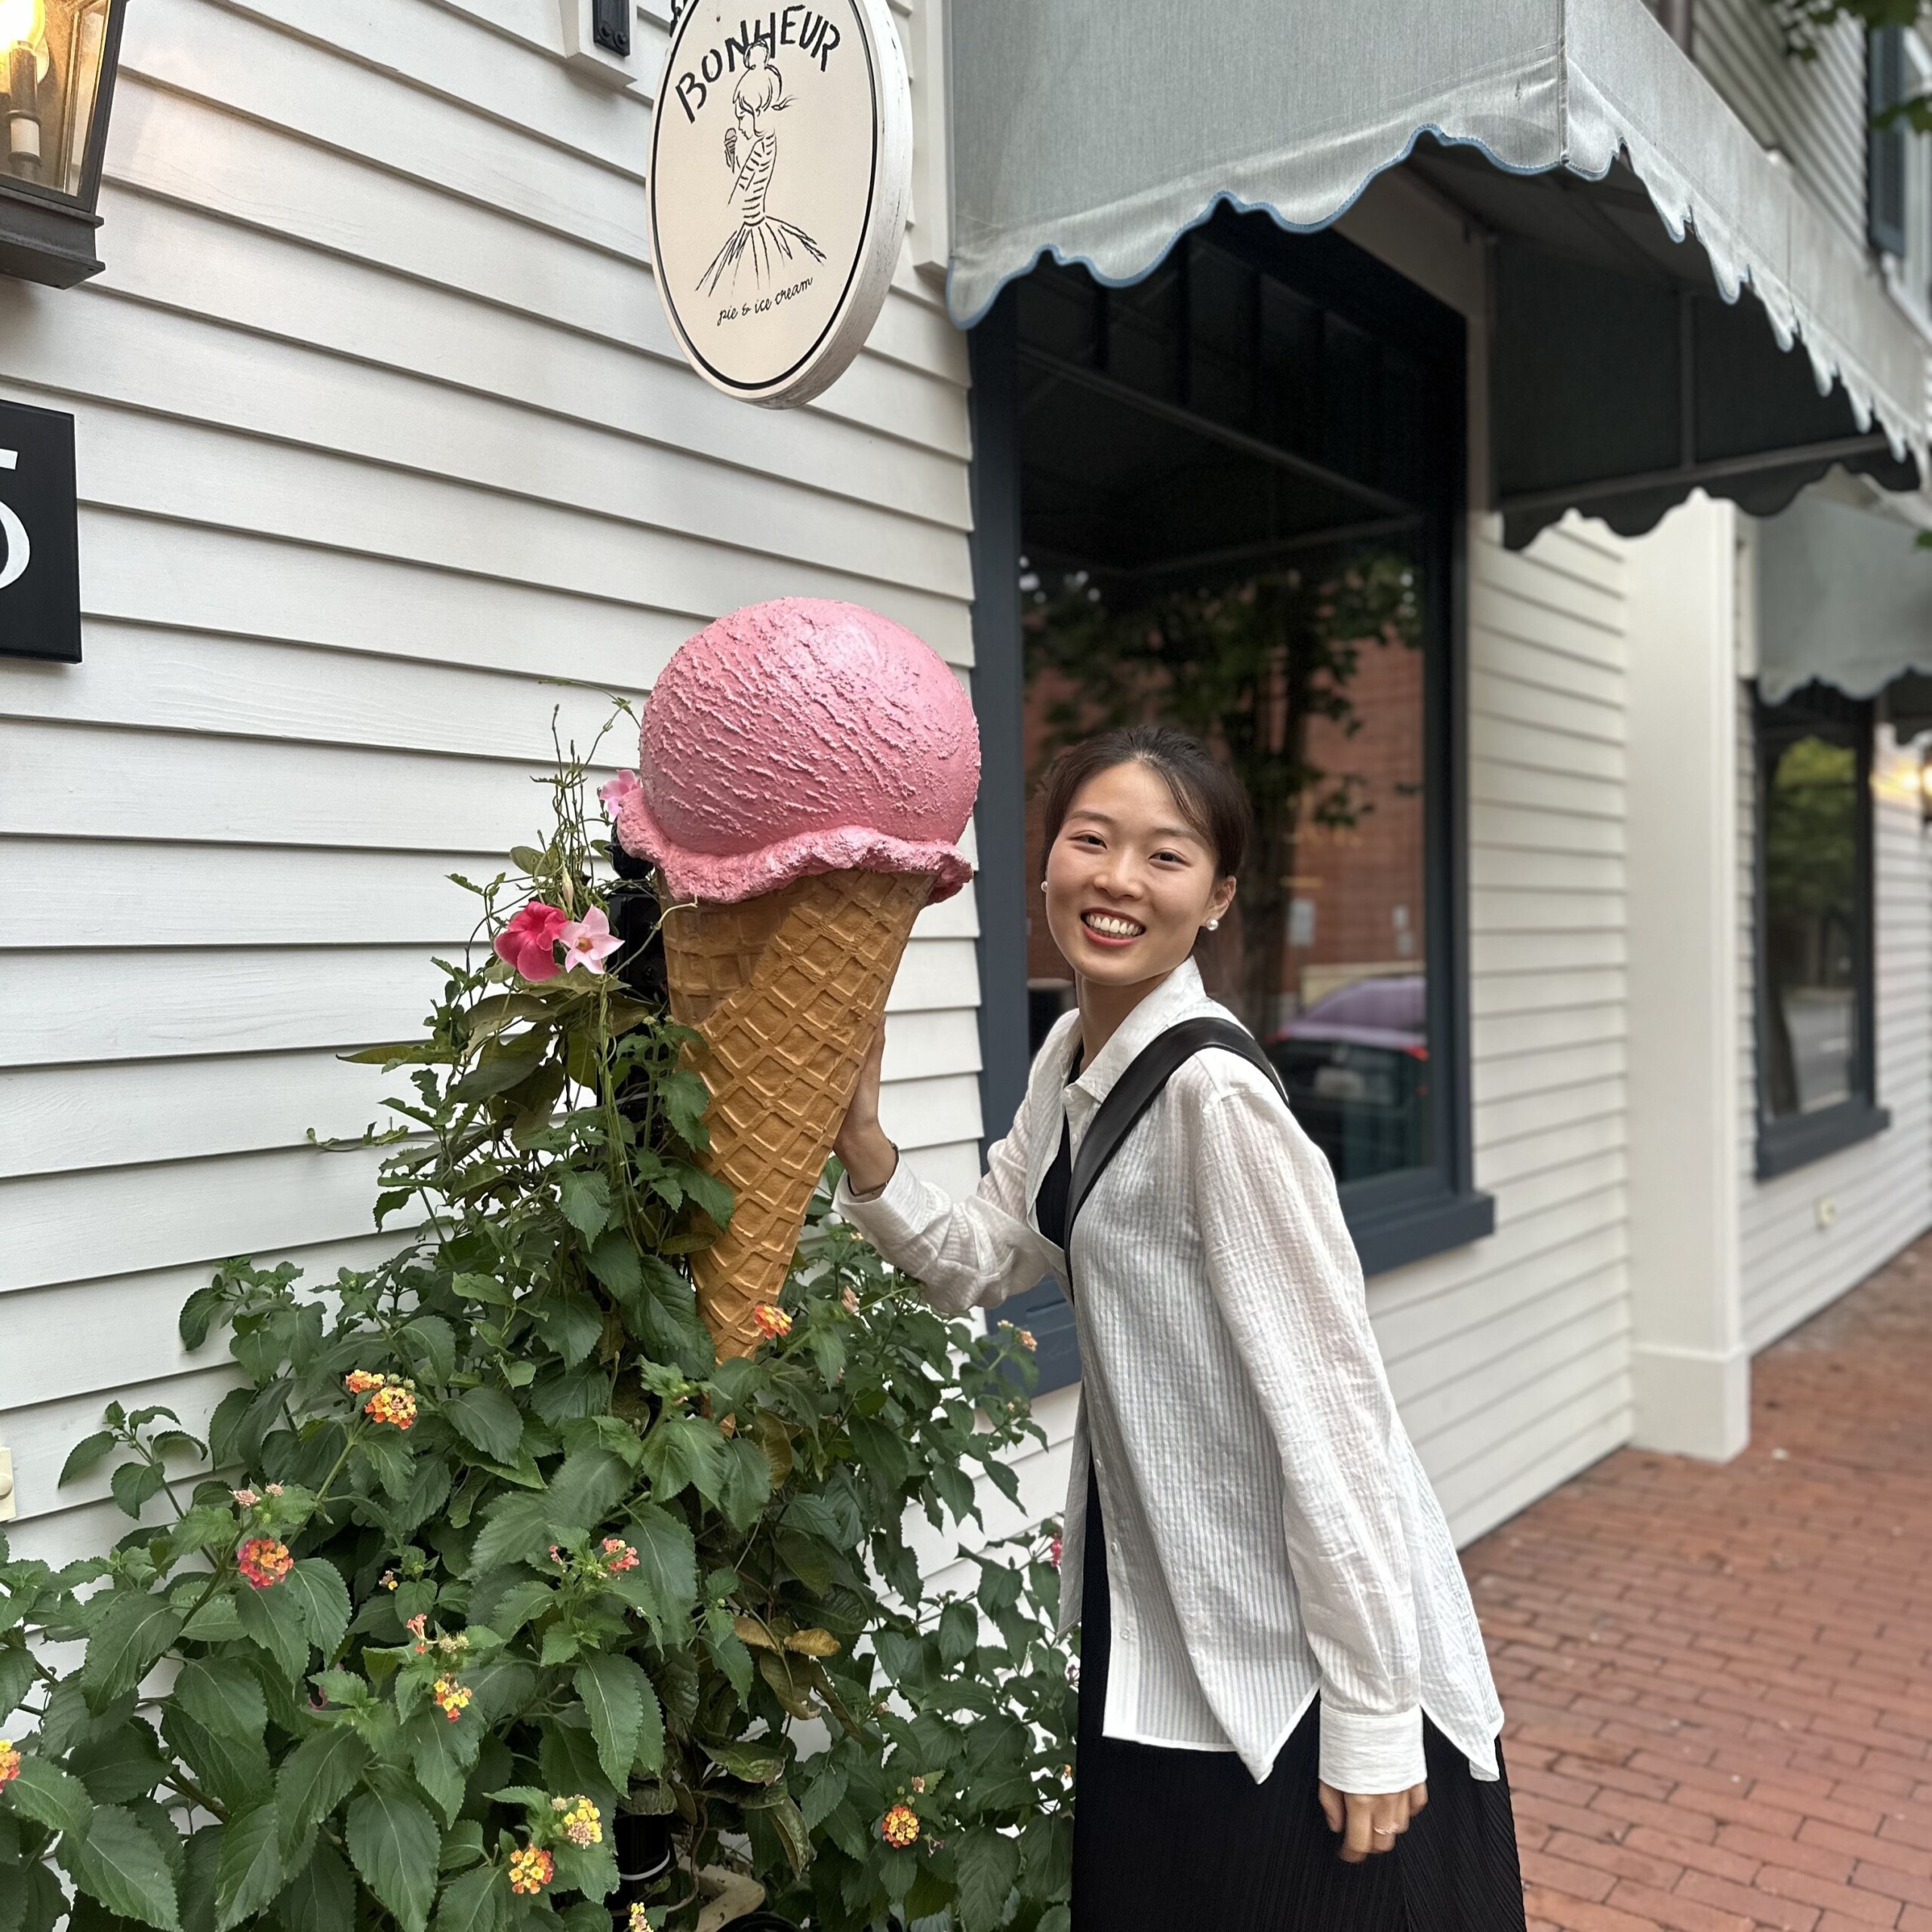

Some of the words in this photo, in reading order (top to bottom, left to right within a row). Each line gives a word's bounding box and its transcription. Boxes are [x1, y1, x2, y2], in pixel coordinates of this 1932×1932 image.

[675, 5, 841, 123] BONHEUR
[717, 305, 738, 326] pie
[742, 303, 752, 316] &
[755, 299, 772, 314] ice
[774, 276, 814, 306] cream
